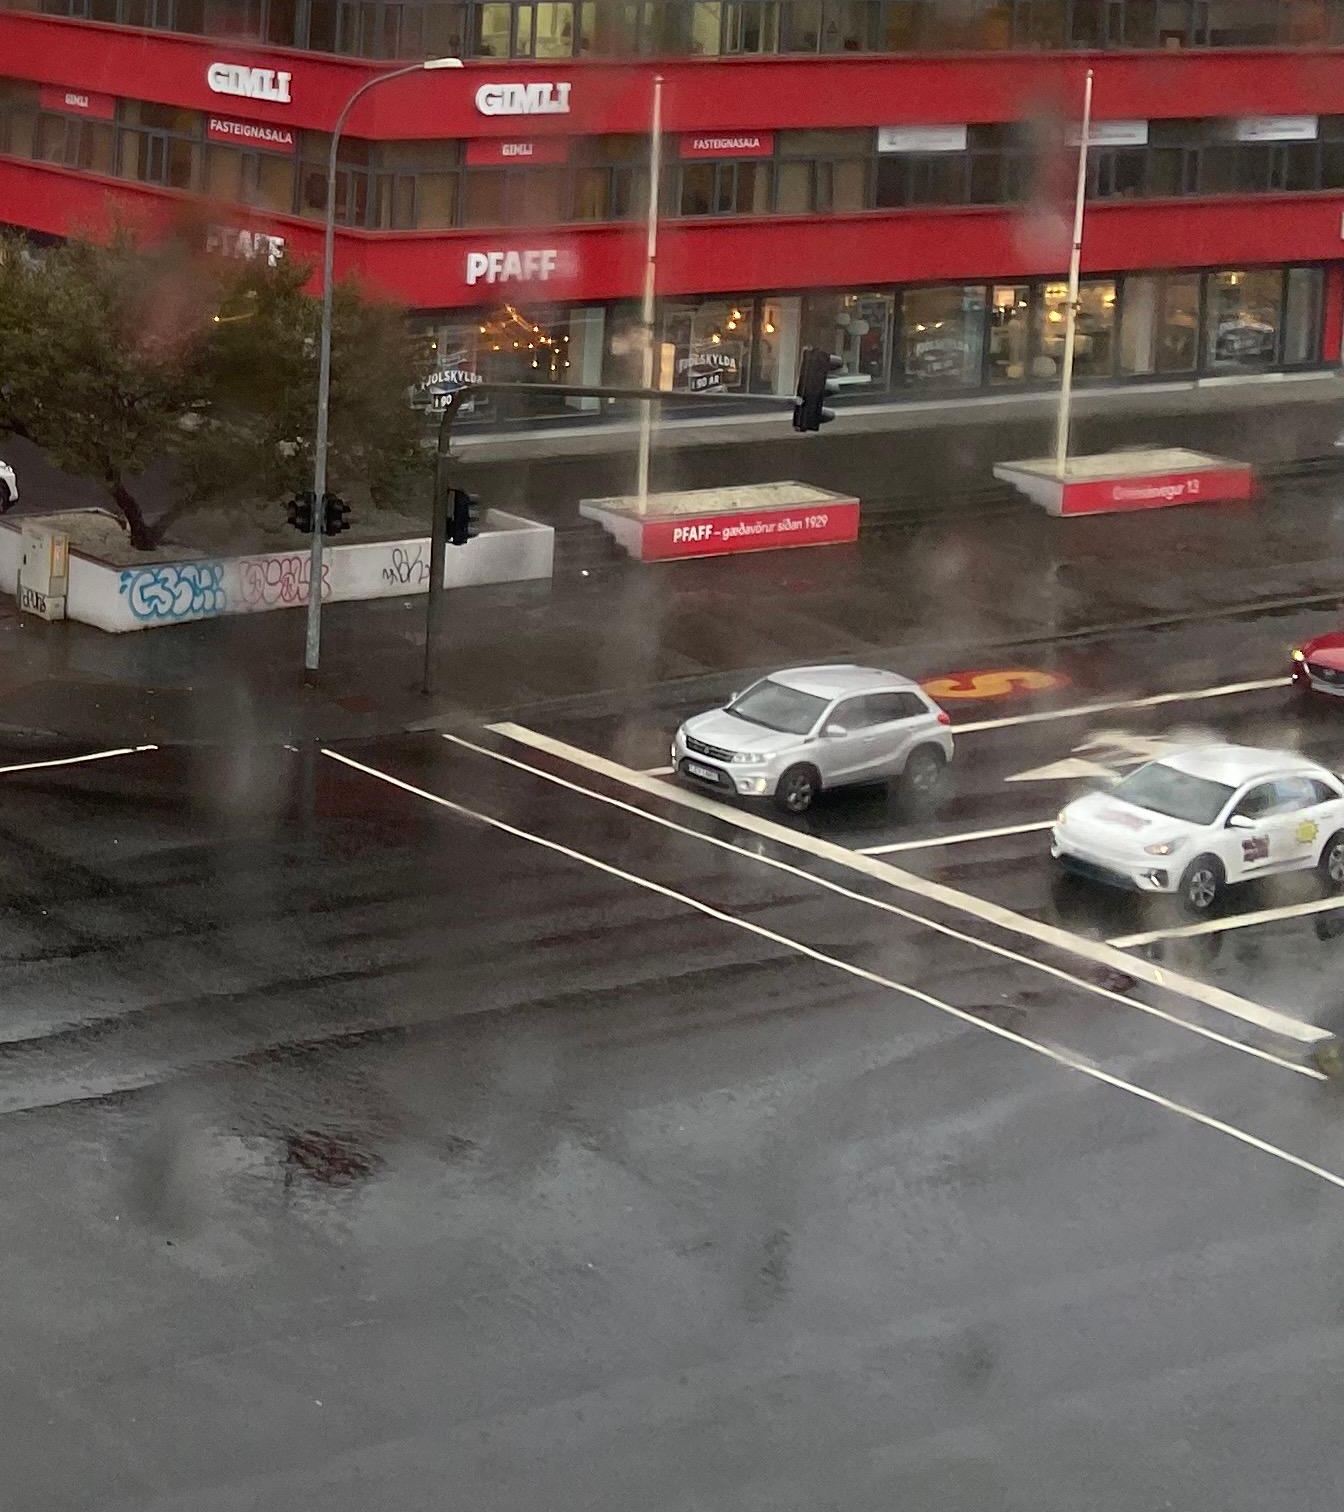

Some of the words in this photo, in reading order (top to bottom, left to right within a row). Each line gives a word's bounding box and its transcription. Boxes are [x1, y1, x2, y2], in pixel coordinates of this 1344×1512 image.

[208, 62, 292, 103] GIMLI
[474, 82, 572, 116] GIMLI
[210, 119, 293, 145] FASTEIGNASALA
[693, 137, 761, 150] FASTEIGNASALA
[467, 250, 558, 285] PFAFF
[673, 524, 714, 543] PFAFF
[805, 514, 829, 529] 1929
